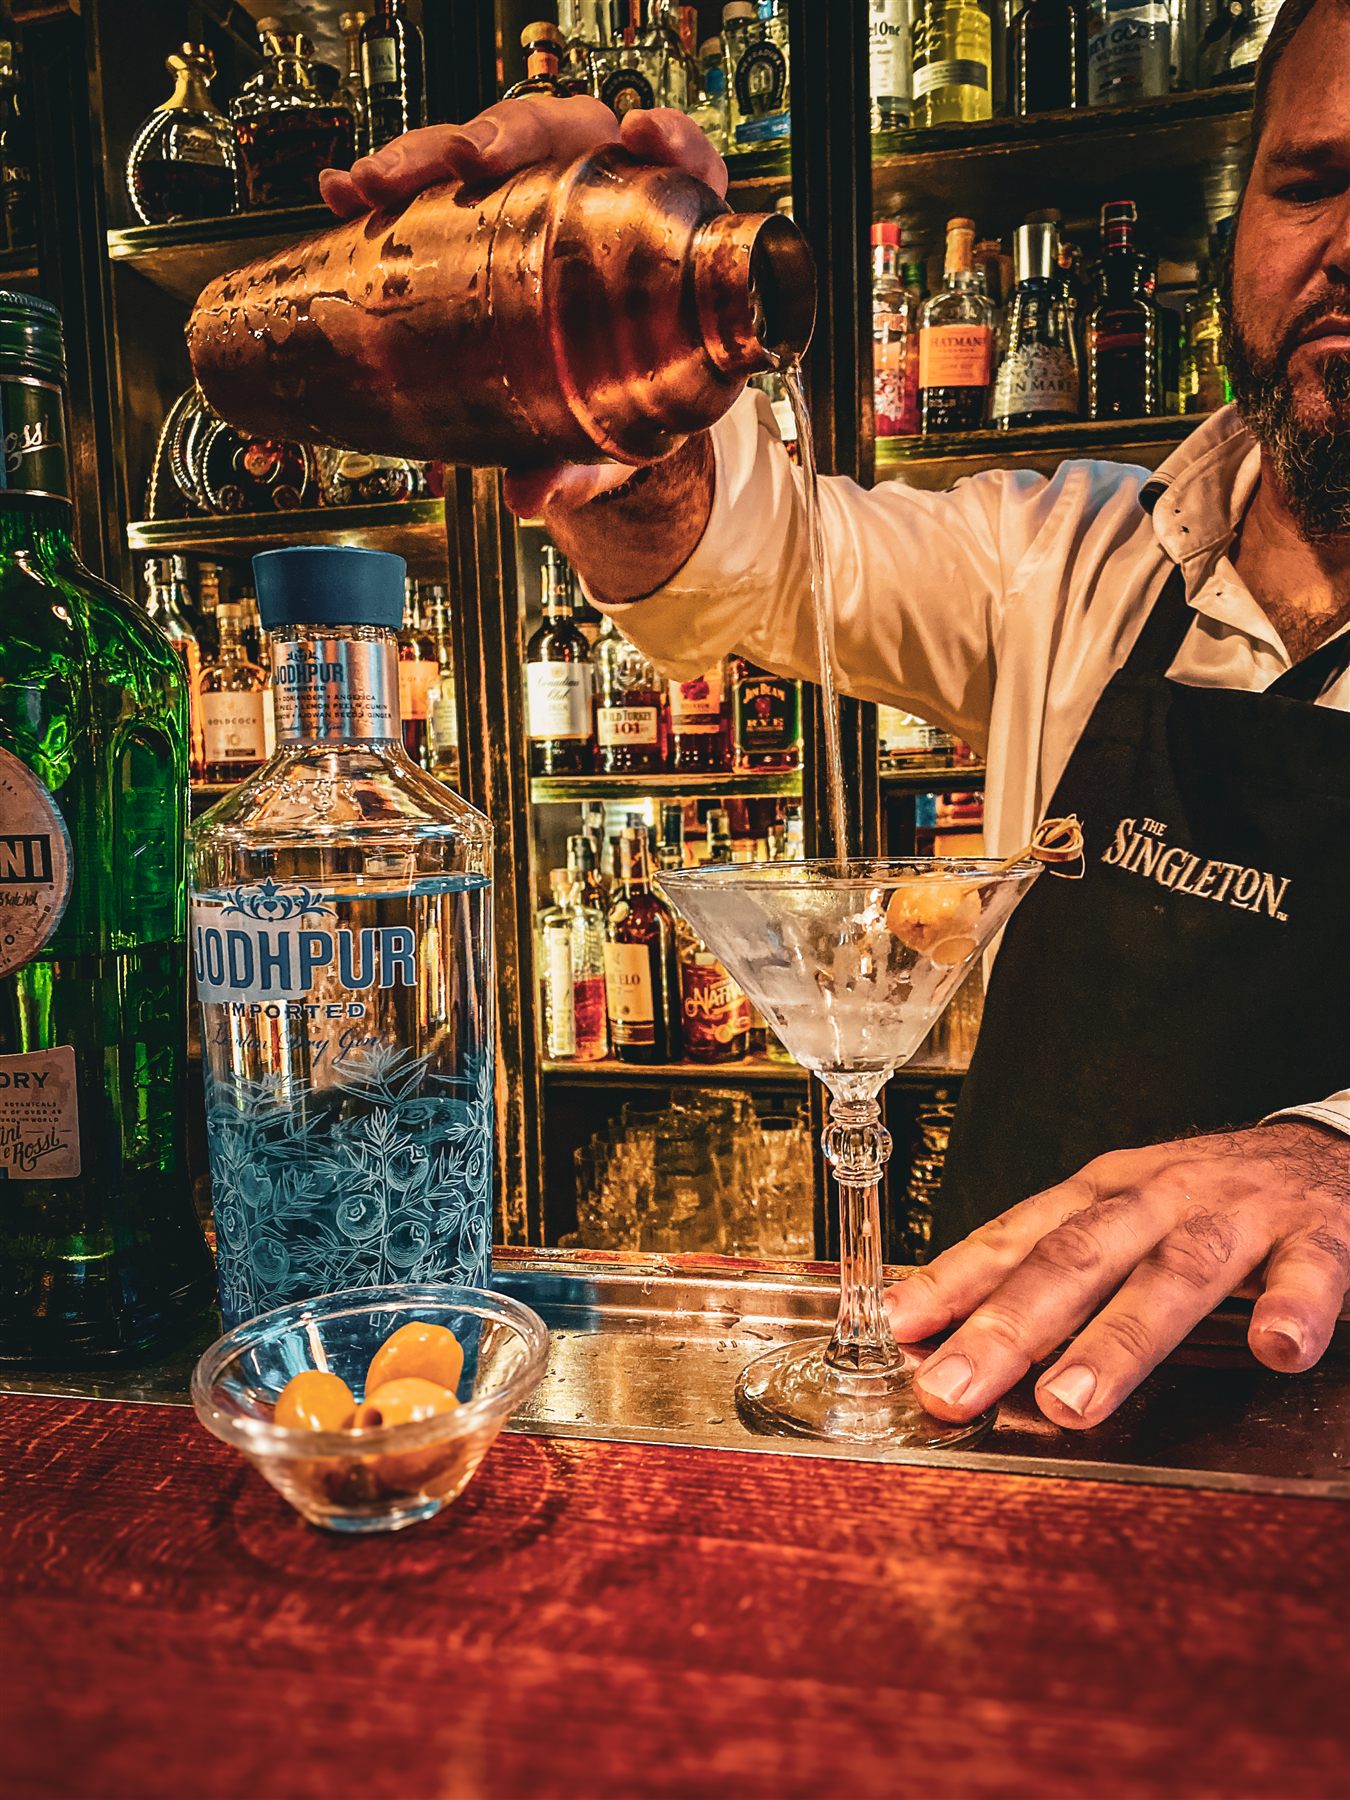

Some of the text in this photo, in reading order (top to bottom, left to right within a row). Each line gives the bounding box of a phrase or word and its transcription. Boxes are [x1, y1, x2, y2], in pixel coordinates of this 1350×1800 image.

[879, 21, 900, 36] One
[273, 663, 344, 685] JODHPUR
[614, 722, 640, 736] 101
[1141, 817, 1168, 837] THE
[1101, 818, 1292, 918] SINGLETON
[194, 925, 417, 991] JODHPUR
[223, 1002, 366, 1020] IMPORTED
[0, 1071, 50, 1089] DRY
[12, 1126, 69, 1173] Rossi
